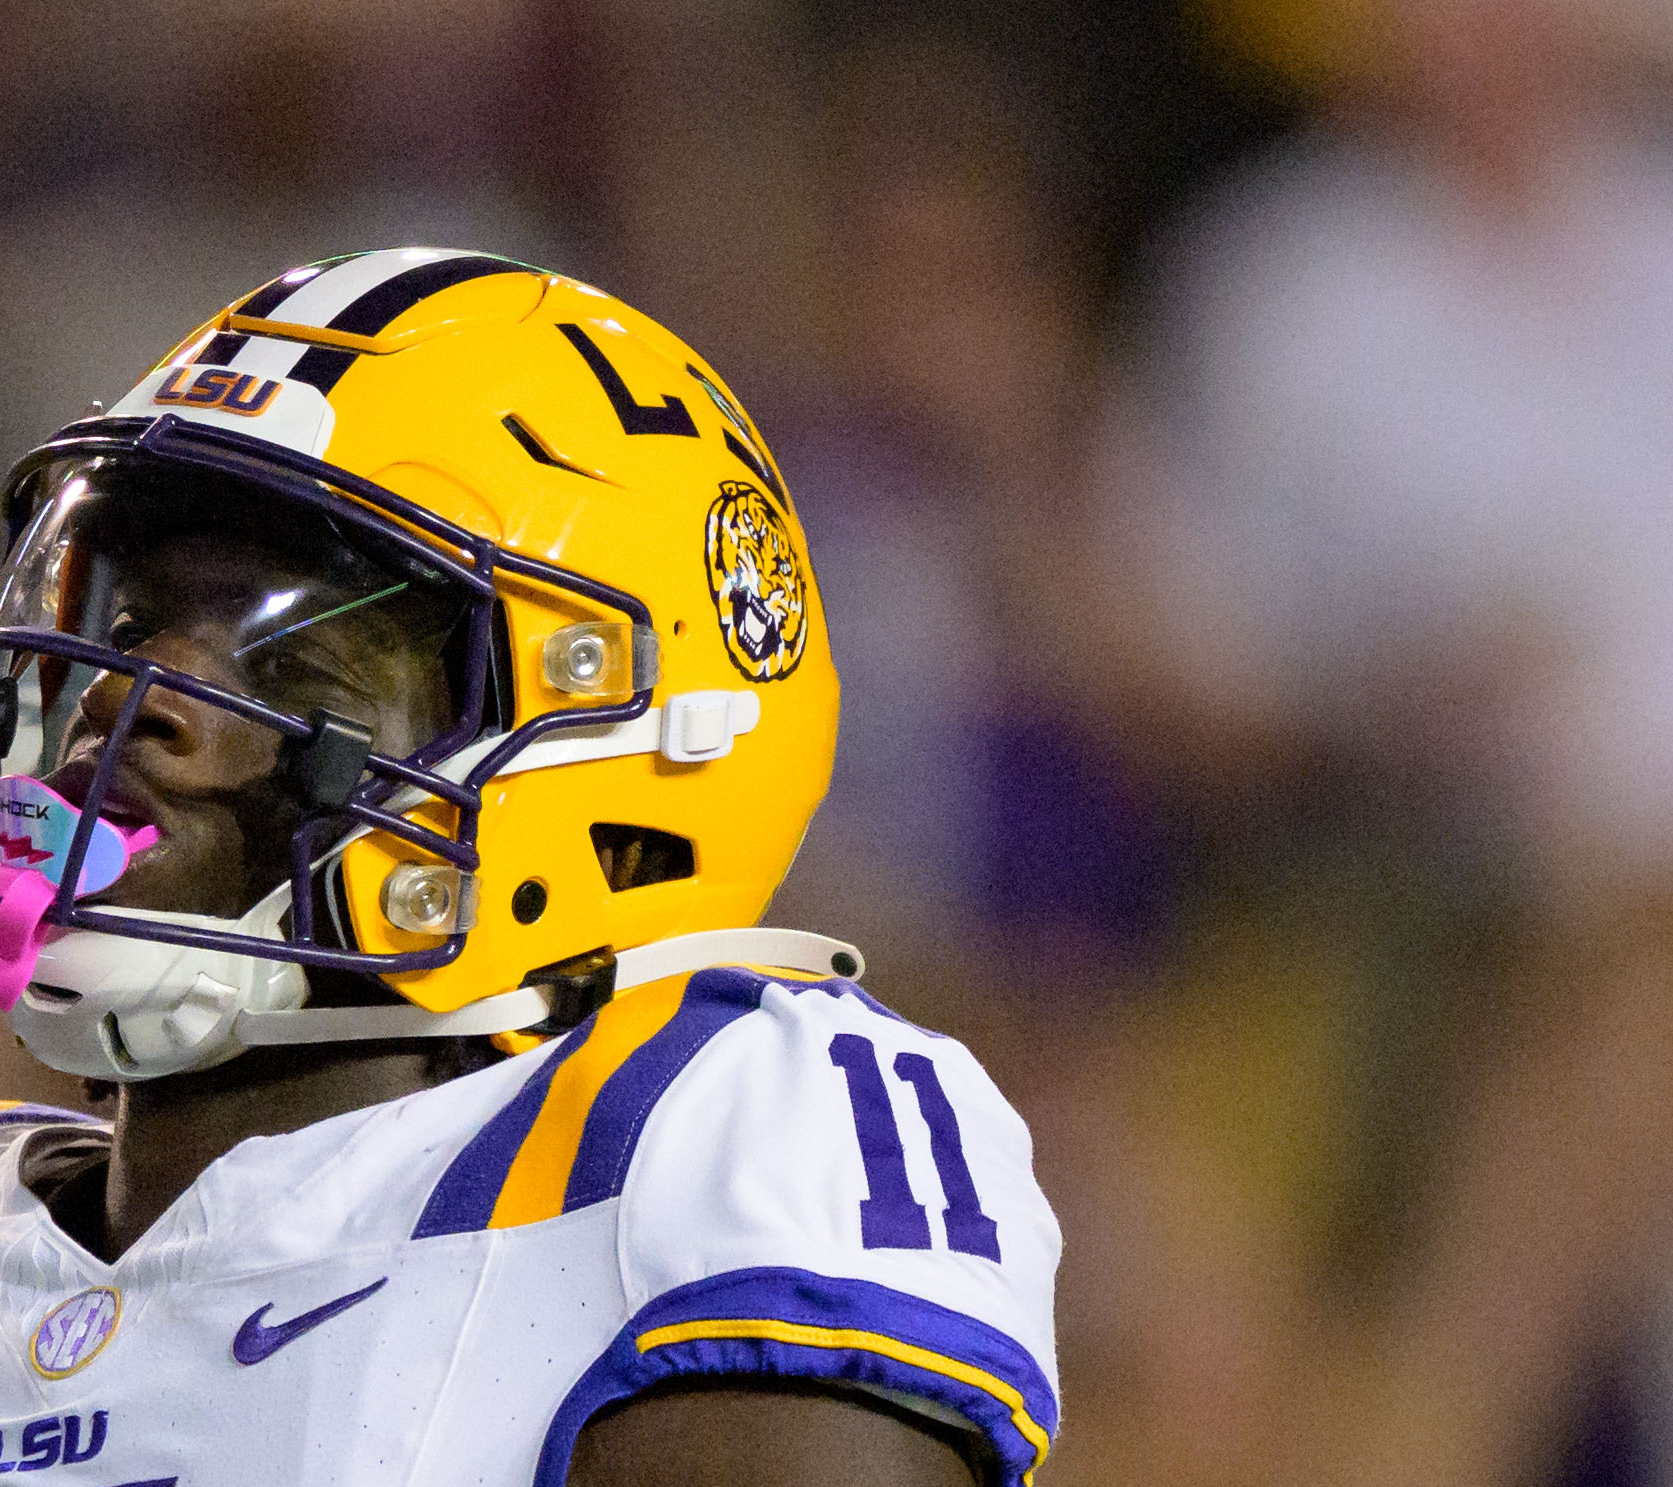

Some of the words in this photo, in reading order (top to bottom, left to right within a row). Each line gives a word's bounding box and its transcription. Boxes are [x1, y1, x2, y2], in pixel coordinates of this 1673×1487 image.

[152, 366, 283, 417] LSU
[828, 1033, 1001, 1265] 11
[36, 1290, 117, 1370] SEC
